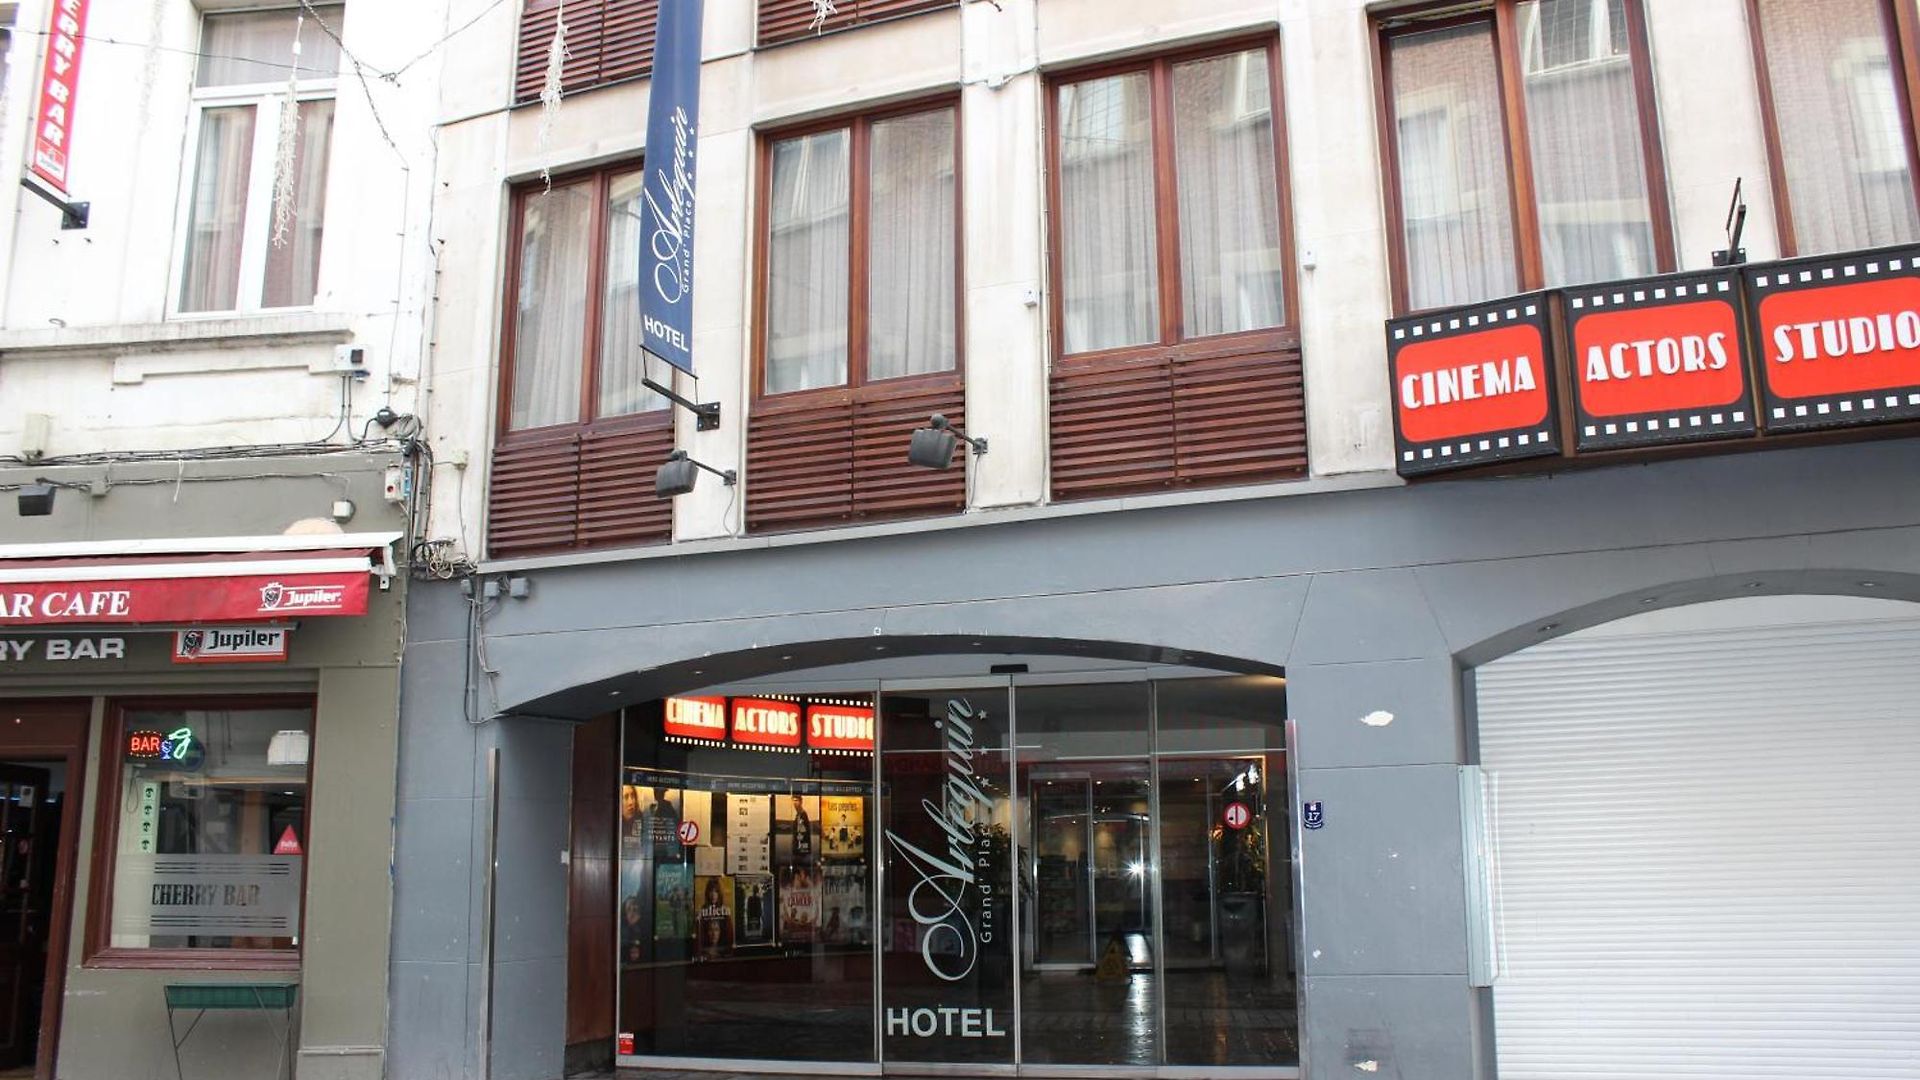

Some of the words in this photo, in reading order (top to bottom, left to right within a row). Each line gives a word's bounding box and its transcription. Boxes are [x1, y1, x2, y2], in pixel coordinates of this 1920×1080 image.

[43, 78, 70, 147] BAR
[683, 201, 693, 239] Place
[644, 315, 689, 352] HOTEL
[1401, 356, 1537, 410] CINEMA
[1586, 332, 1729, 383] ACTORS
[1773, 310, 1920, 363] STUDIO
[42, 591, 130, 616] CAFE
[46, 638, 125, 660] BAR
[207, 630, 280, 651] Jupiler
[667, 698, 726, 729] CINEMA
[735, 707, 798, 735] ACTORS
[131, 737, 160, 751] BAR
[1308, 812, 1321, 821] 17
[152, 884, 218, 906] CHERRY
[223, 884, 260, 906] BAR
[887, 1007, 1006, 1038] HOTEL
